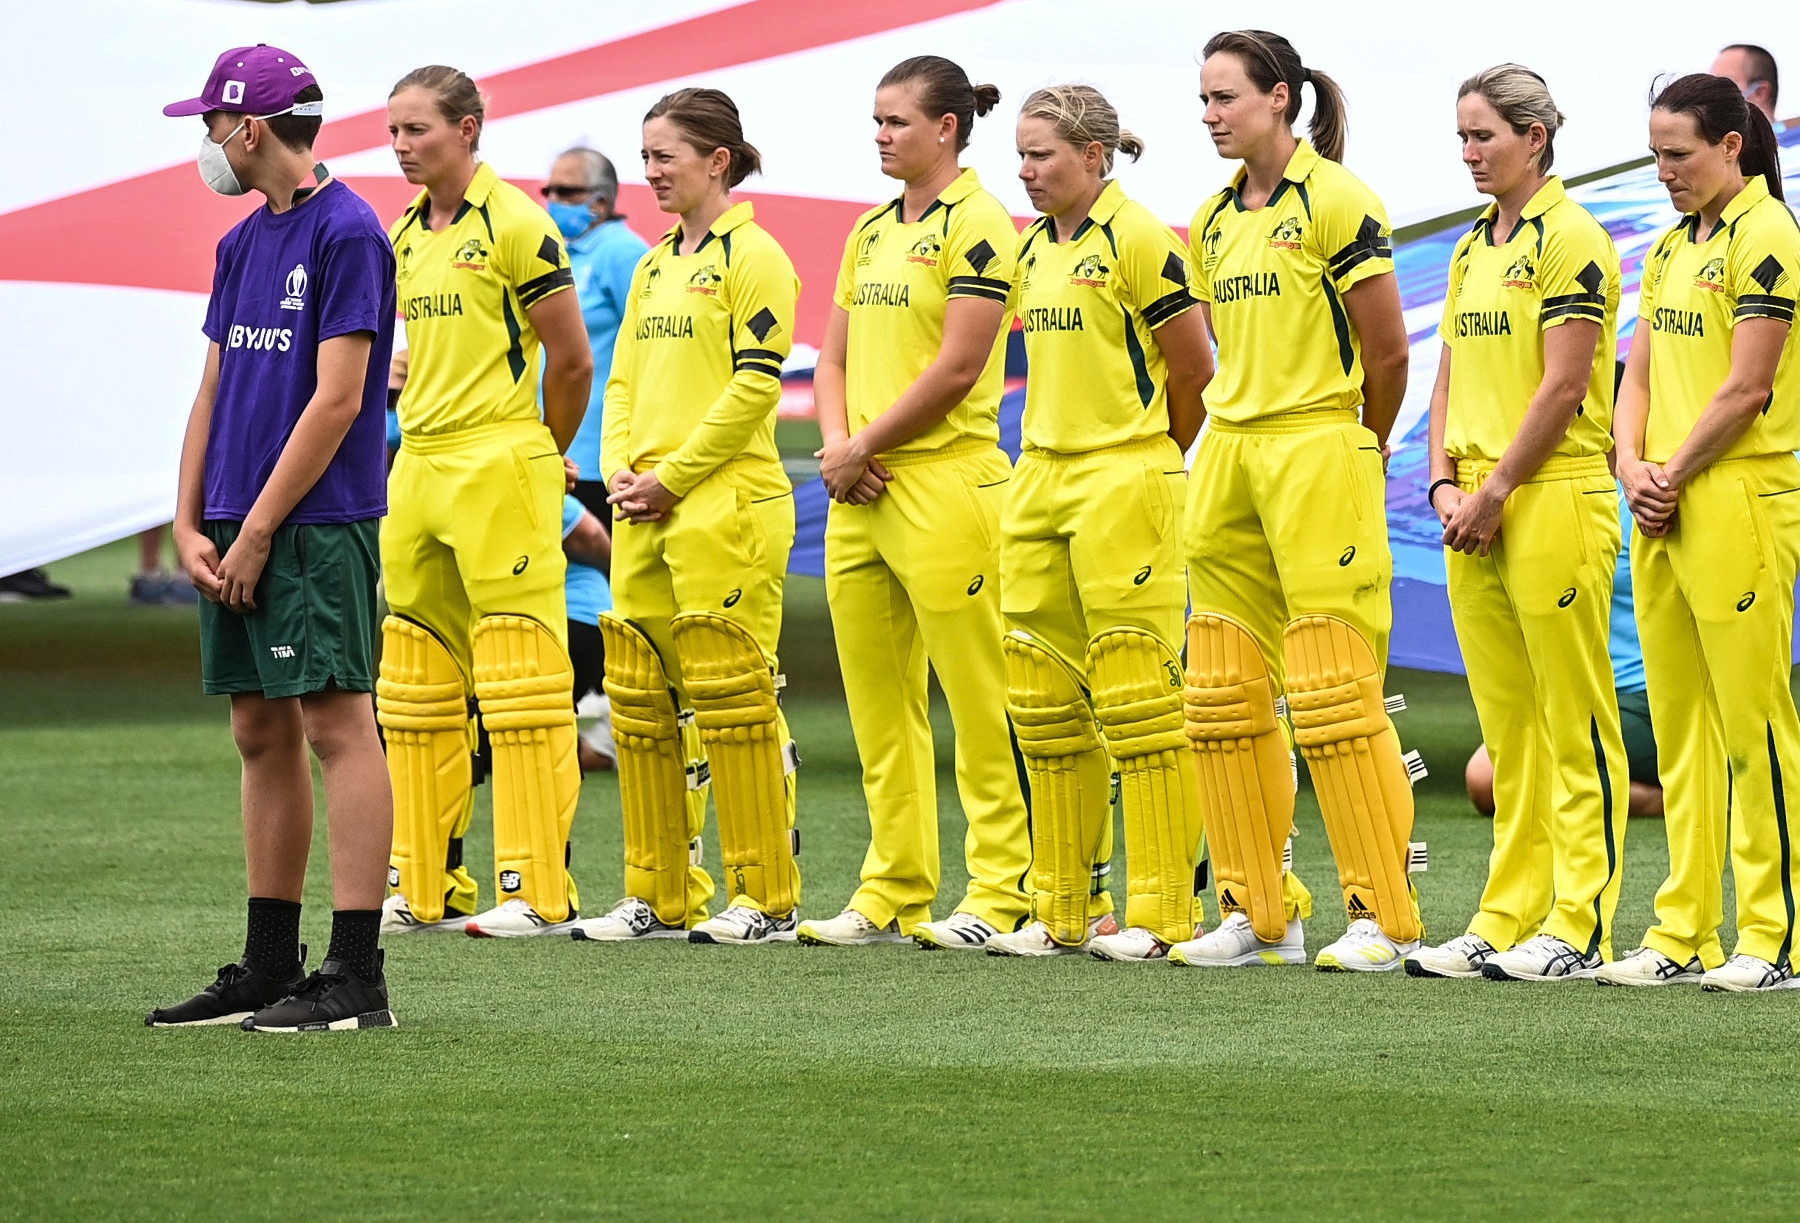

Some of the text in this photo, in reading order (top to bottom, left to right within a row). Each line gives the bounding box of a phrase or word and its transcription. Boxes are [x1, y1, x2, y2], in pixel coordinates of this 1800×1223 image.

[853, 282, 910, 308] USTRALIA
[1213, 272, 1281, 305] AUSTRALIA
[404, 292, 463, 322] USTRALIA
[230, 324, 293, 352] BYJU'S
